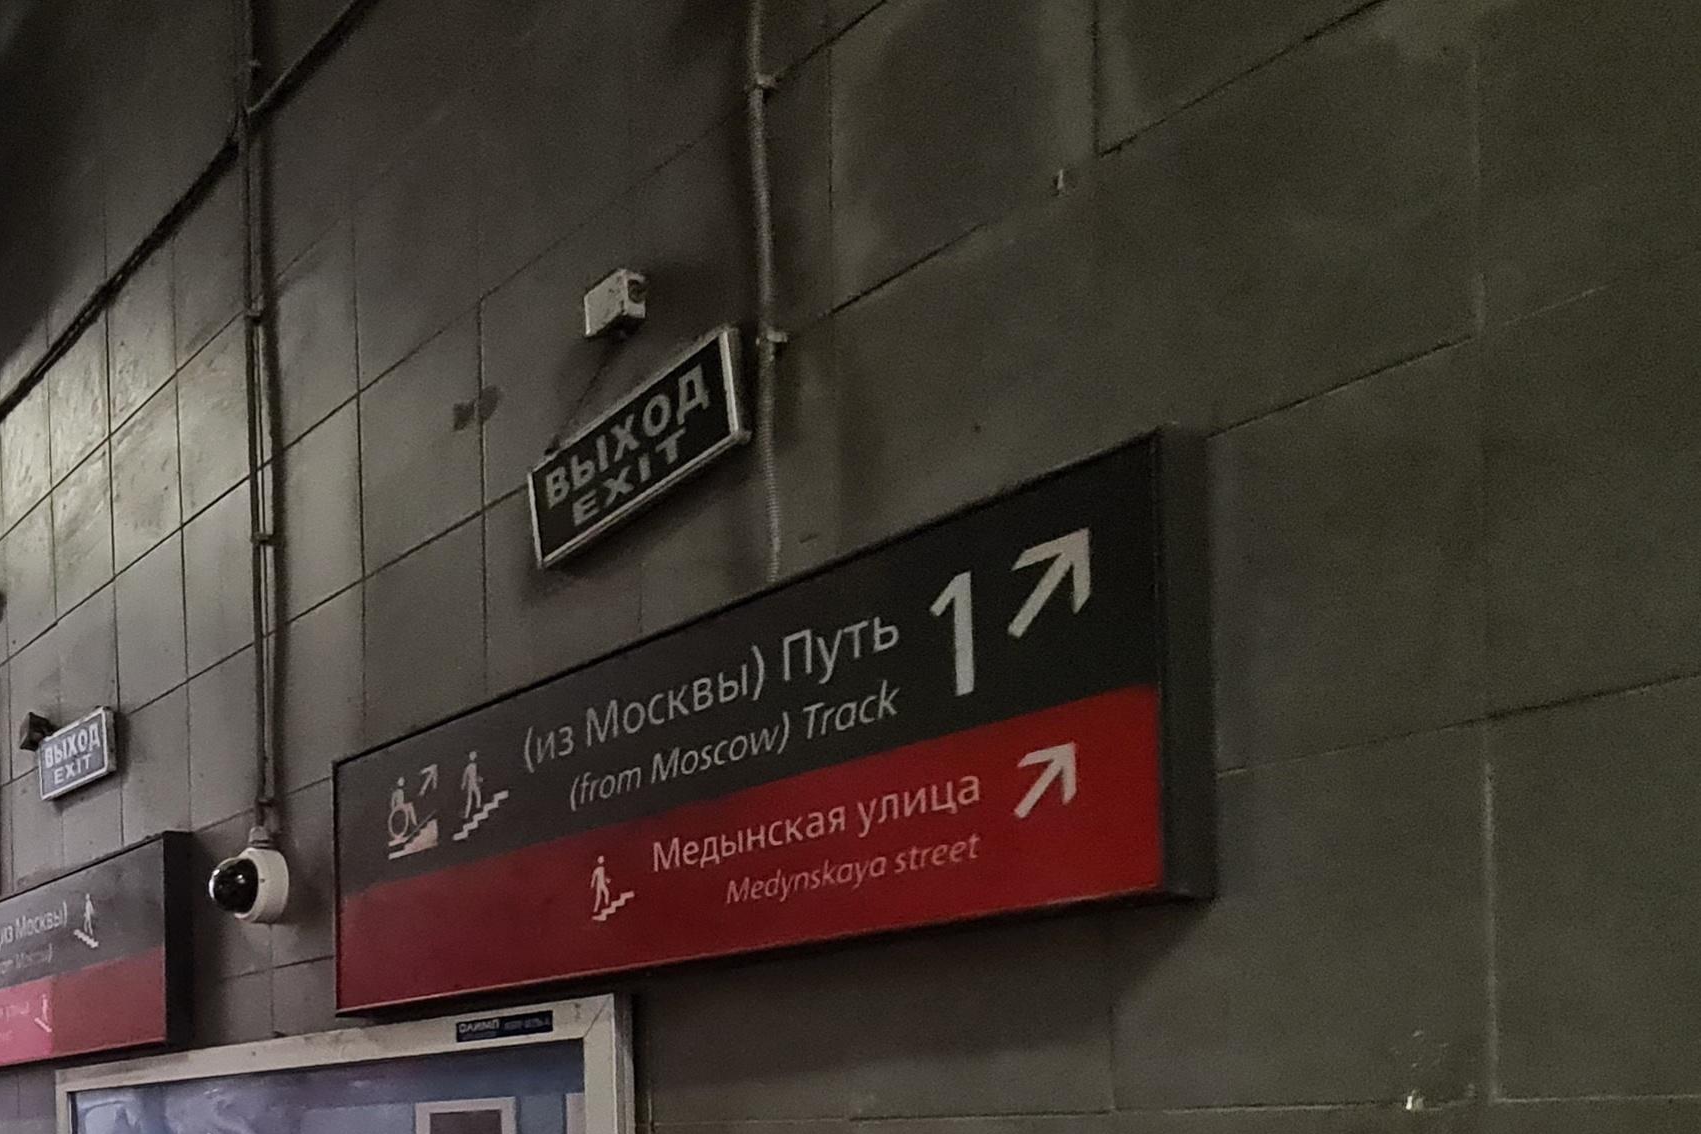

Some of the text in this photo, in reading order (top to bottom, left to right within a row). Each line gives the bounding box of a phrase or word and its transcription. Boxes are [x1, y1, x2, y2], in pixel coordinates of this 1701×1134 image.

[545, 362, 710, 510] ВЫХОД
[572, 426, 687, 527] EXIT
[522, 570, 977, 774] (из Москвы) Путь 1
[44, 722, 101, 769] ВЫХОД
[54, 753, 92, 785] EXIT
[568, 680, 900, 812] (from Moscow) Track
[652, 774, 982, 873] Медынская улица
[725, 832, 982, 904] Medynskaya street
[15, 900, 68, 941] Москвы)
